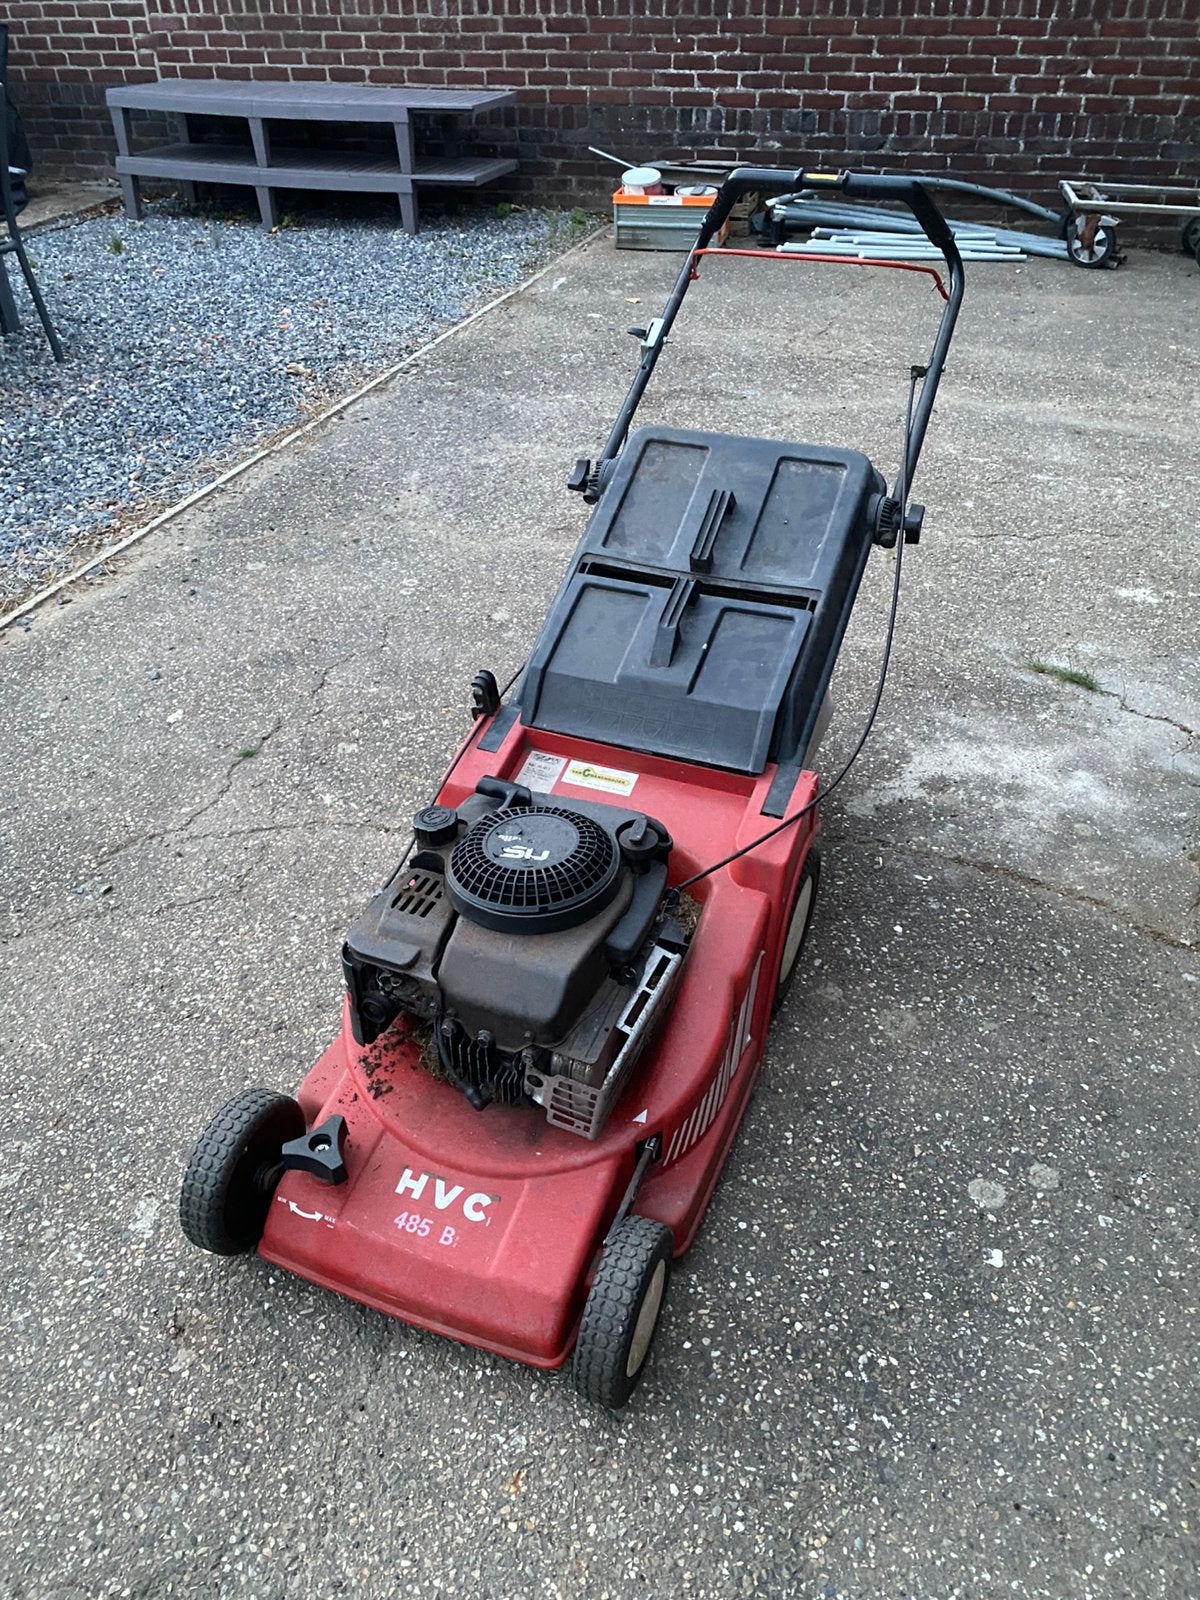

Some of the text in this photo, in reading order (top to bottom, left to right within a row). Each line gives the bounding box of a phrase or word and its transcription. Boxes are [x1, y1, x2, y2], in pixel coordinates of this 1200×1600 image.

[394, 1167, 493, 1223] HVC
[323, 1214, 337, 1224] MAX
[393, 1211, 456, 1247] 485 B
